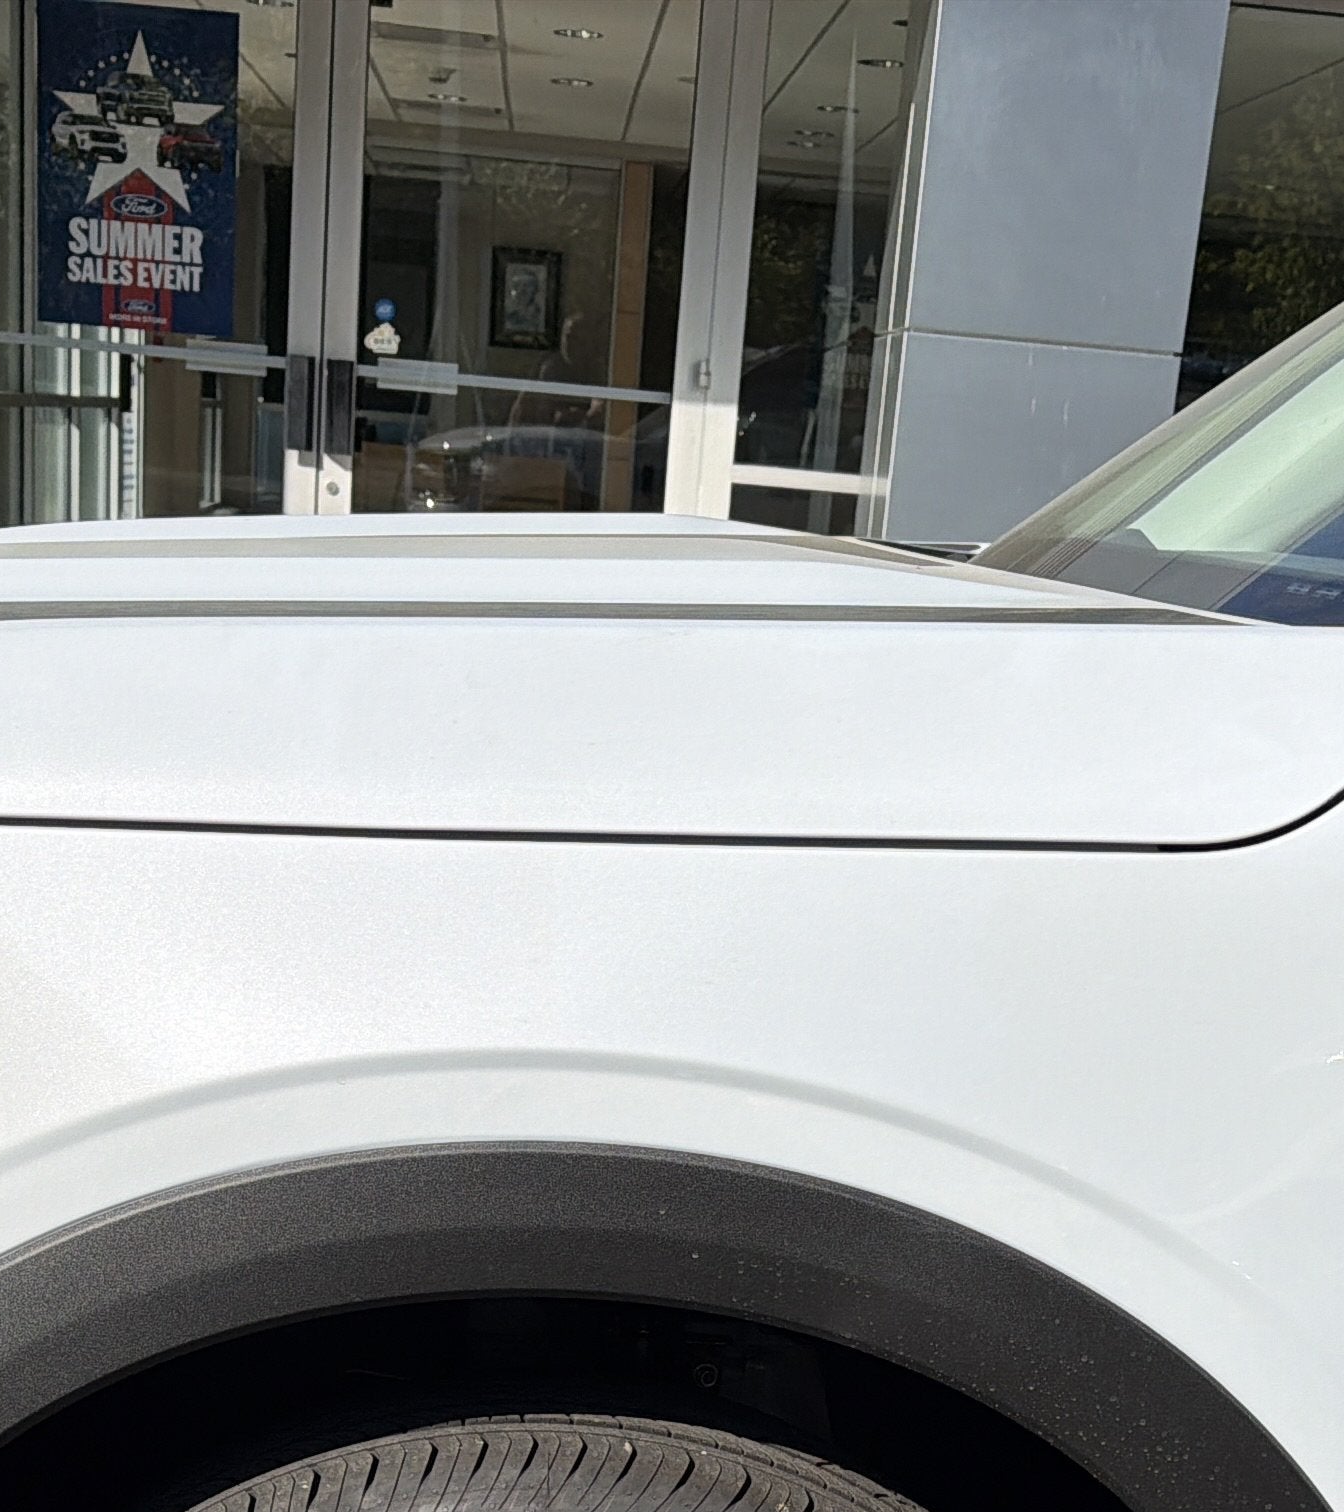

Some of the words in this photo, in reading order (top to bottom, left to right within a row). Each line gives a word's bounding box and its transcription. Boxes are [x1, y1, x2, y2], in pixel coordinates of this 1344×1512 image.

[68, 216, 204, 264] SUMMER
[67, 256, 133, 286] SALES
[137, 261, 203, 292] EVENT
